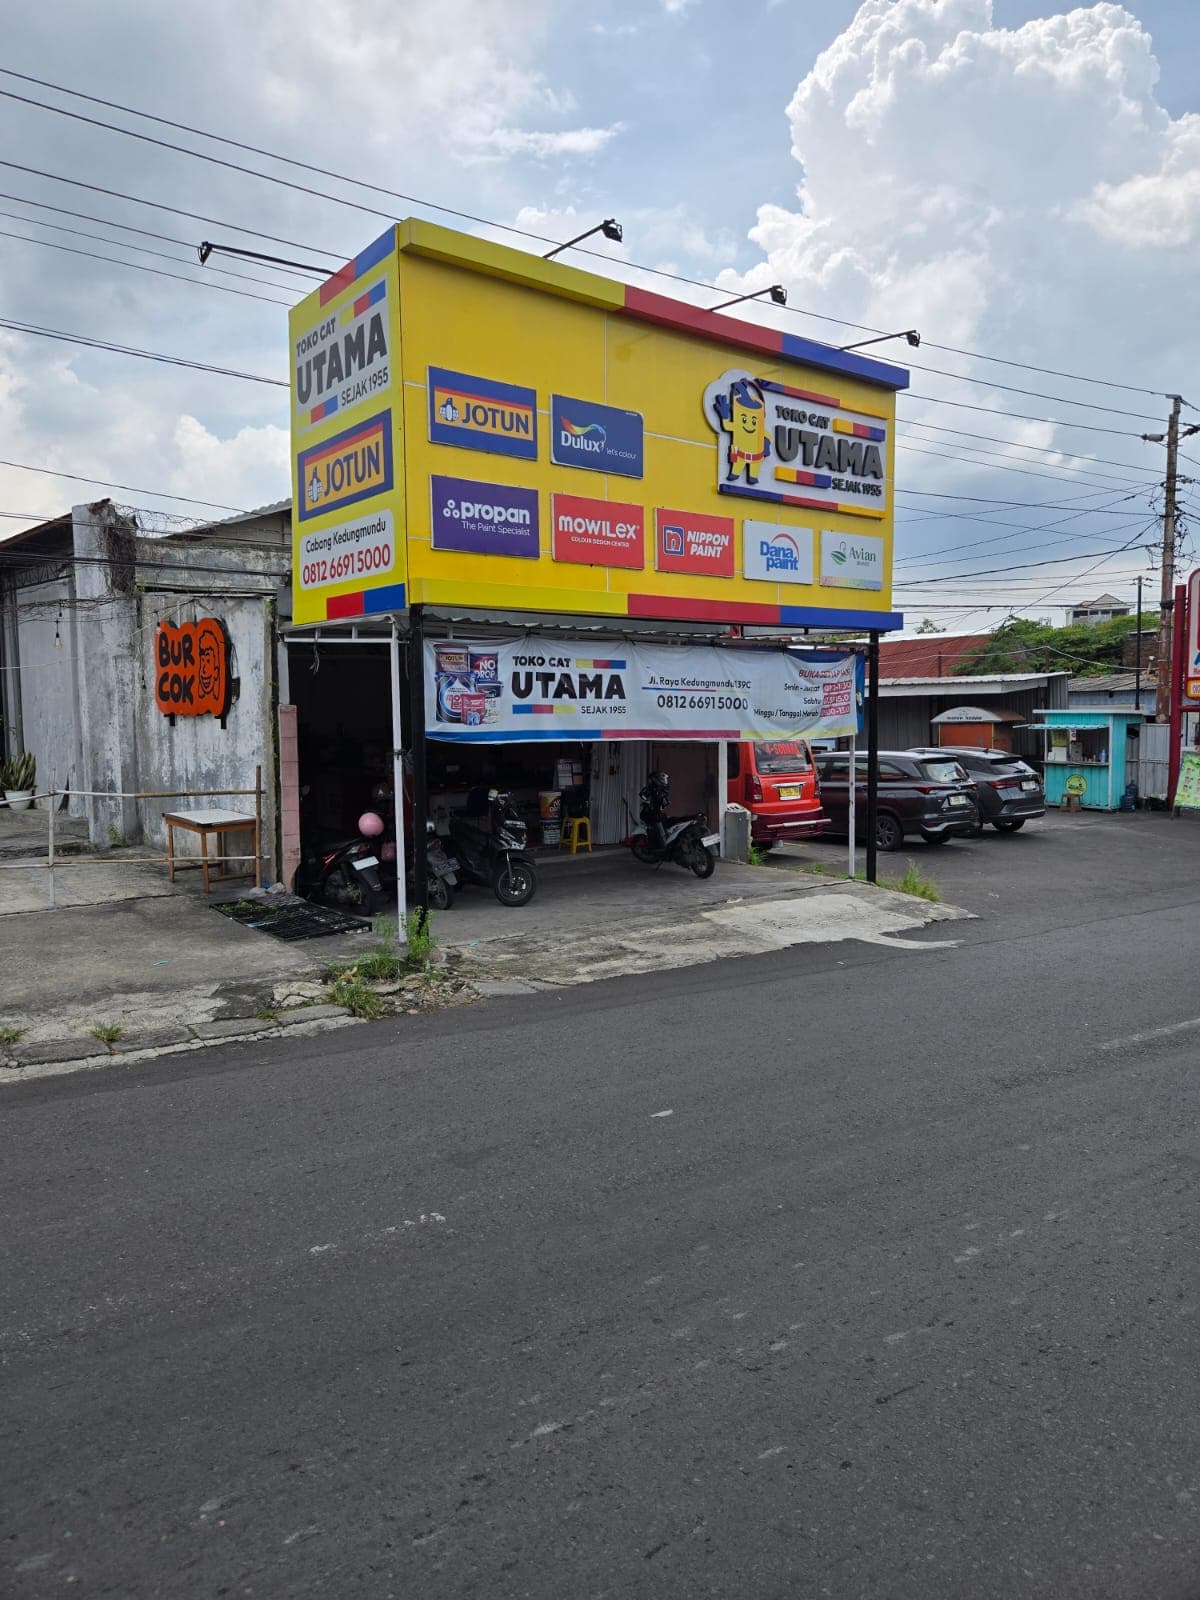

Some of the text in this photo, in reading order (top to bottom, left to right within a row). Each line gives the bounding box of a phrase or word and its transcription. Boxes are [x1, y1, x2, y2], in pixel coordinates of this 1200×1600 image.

[296, 316, 336, 358] TOKO CAT
[297, 312, 388, 404] UTAMA
[341, 366, 388, 406] SEJAK 1955
[462, 402, 529, 434] JOTUN
[775, 405, 830, 429] TOKO CAT
[560, 431, 600, 453] Dulux
[775, 425, 884, 480] UTAMA
[324, 440, 380, 496] JOTUN
[832, 477, 882, 496] SEJAK 1955
[460, 501, 530, 524] propan
[306, 517, 386, 554] Cabang Kedungmundu
[461, 520, 530, 536] The Paint Specialist
[686, 530, 730, 546] NIPPON
[690, 544, 722, 558] PAINT
[760, 541, 794, 558] Dana
[850, 546, 876, 562] Avian
[302, 543, 391, 586] 0812 6691 5000
[766, 554, 798, 572] paint
[159, 631, 194, 668] BUR
[480, 659, 496, 670] NO
[512, 656, 572, 668] TOKO CAT
[158, 672, 194, 705] COK
[512, 671, 626, 700] UTAMA
[648, 676, 659, 685] Jl.
[660, 676, 680, 687] Raya
[580, 706, 627, 714] SEJAK 1955
[657, 694, 748, 710] 0812 6691 5000
